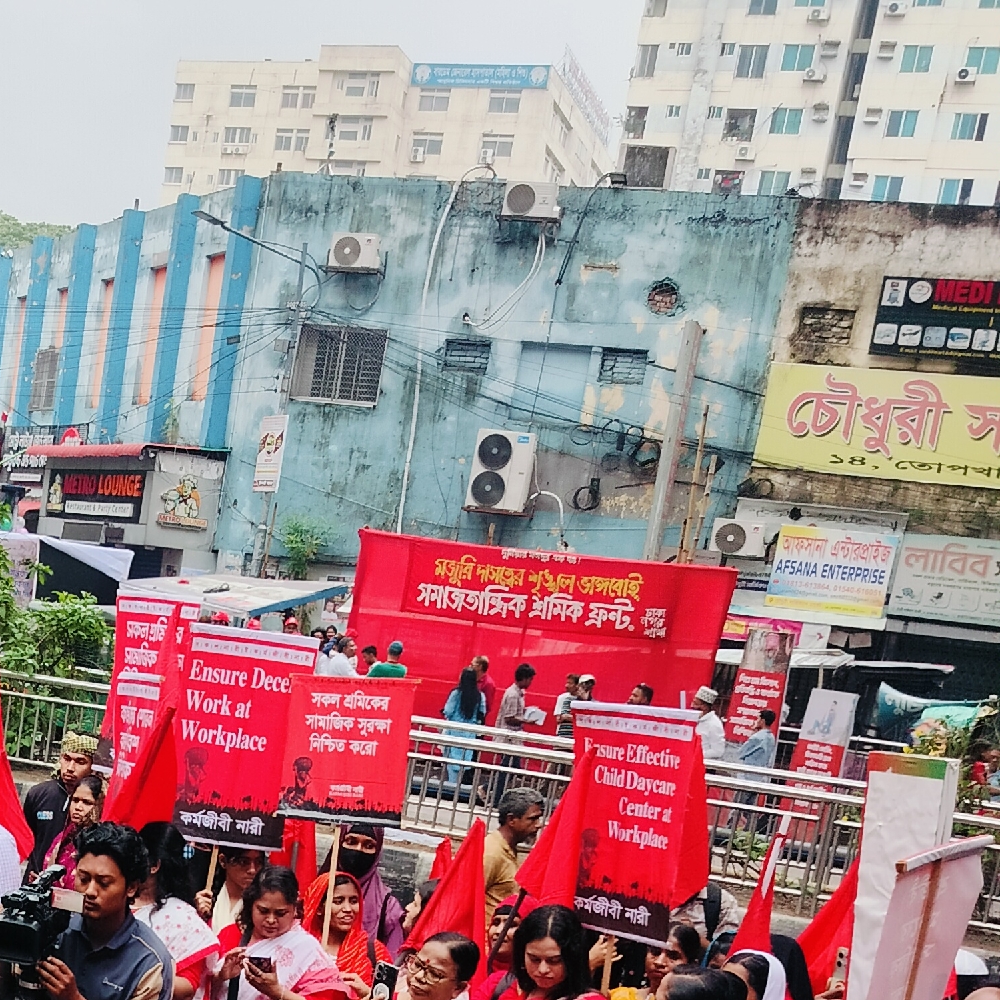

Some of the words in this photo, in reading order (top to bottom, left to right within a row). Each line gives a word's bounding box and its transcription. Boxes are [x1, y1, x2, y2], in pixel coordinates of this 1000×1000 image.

[934, 279, 994, 304] MEDI
[787, 373, 951, 458] চৌধুরী
[829, 454, 879, 470] ১৪,
[63, 474, 97, 495] METRO
[98, 474, 142, 497] LOUNGE
[159, 514, 181, 524] METRO
[782, 535, 829, 559] আফসানা
[904, 543, 994, 578] লাবিব
[434, 554, 477, 588] মজুরি
[775, 559, 817, 578] AFSANA
[821, 565, 886, 586] ENTERPRISE
[417, 582, 528, 619] সমাজতান্ত্রিক
[529, 592, 585, 622] শ্রমিক
[189, 659, 247, 688] Ensure
[186, 689, 232, 716] Work
[235, 700, 252, 719] at
[311, 692, 342, 711] সকল
[343, 690, 391, 712] শ্রমিকের
[181, 719, 268, 753] Workplace
[305, 711, 355, 732] সামাজিক
[357, 717, 392, 737] সুরক্ষা
[309, 733, 347, 753] নিশ্চিত
[348, 740, 379, 757] করো
[626, 743, 680, 770] Effective
[594, 765, 625, 788] Child
[627, 770, 677, 797] Daycare
[179, 809, 233, 832] কর্মজীবী
[235, 816, 265, 836] নারী
[619, 796, 661, 821] Center
[662, 807, 672, 823] at
[608, 820, 669, 850] Workplace
[573, 894, 623, 920] কর্মজীবী
[625, 905, 651, 927] নারী
